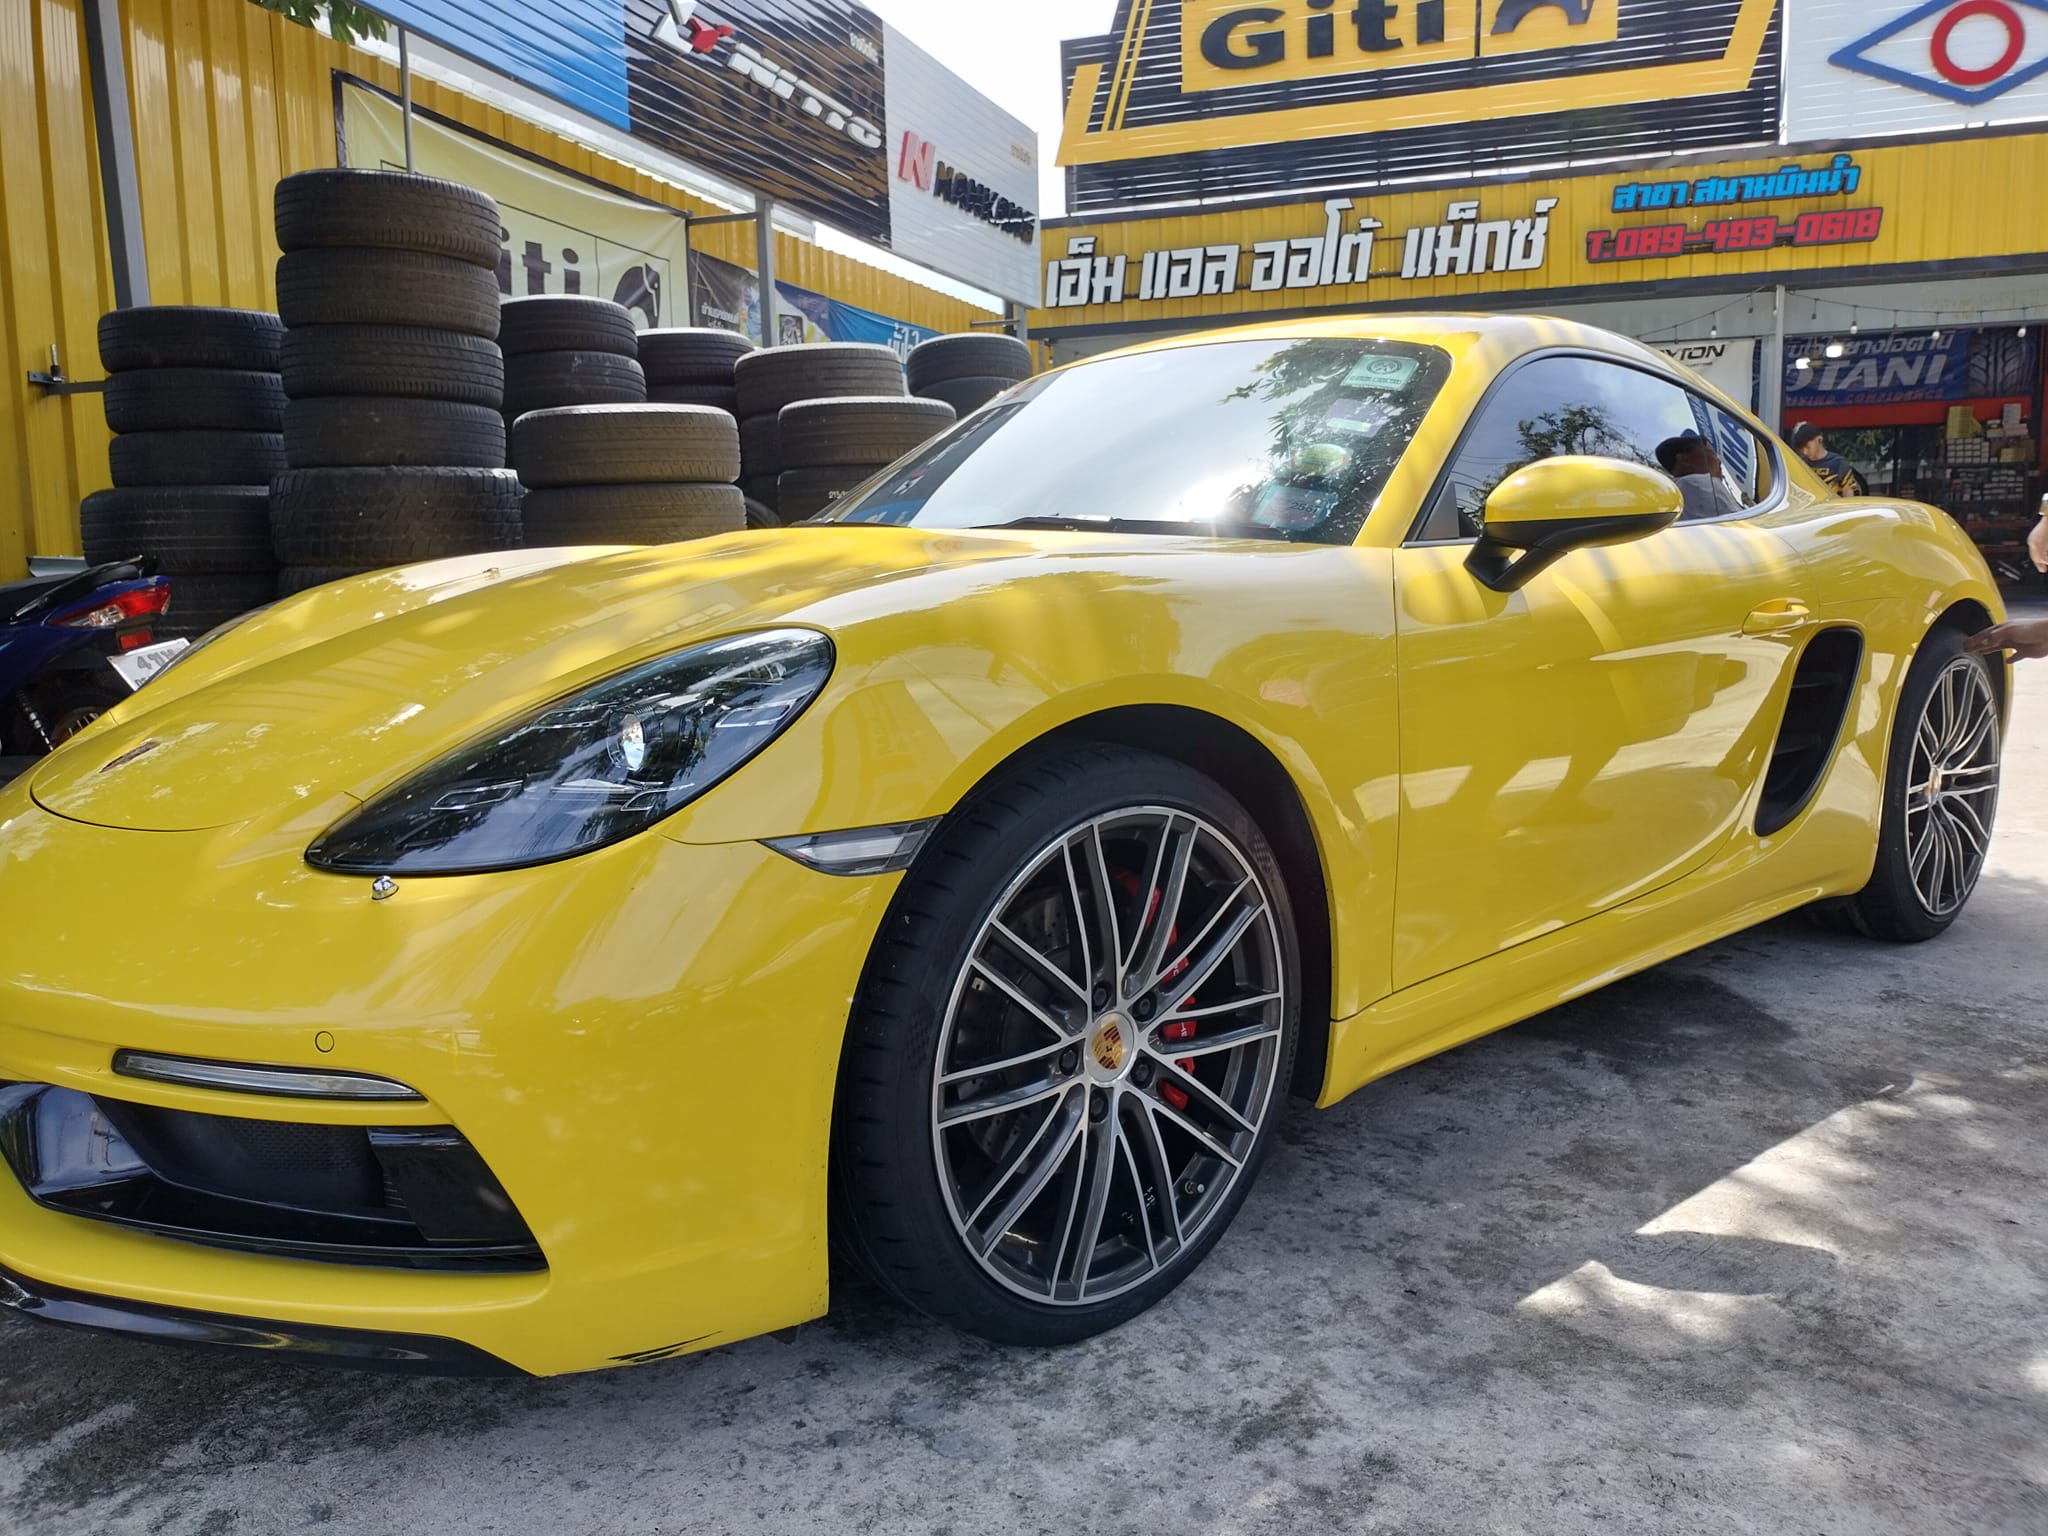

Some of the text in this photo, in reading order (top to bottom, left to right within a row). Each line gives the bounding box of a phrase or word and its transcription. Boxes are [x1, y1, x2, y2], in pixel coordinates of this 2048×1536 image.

[1200, 0, 1446, 70] Giti
[1612, 154, 1861, 212] สาขา สนามบินน้ำ
[495, 226, 581, 296] iti
[1045, 197, 1559, 308] เอ็ม แอล ออโต้ แม็กซ์
[1587, 207, 1883, 263] T.089-493-0618
[1661, 344, 1725, 360] YTON
